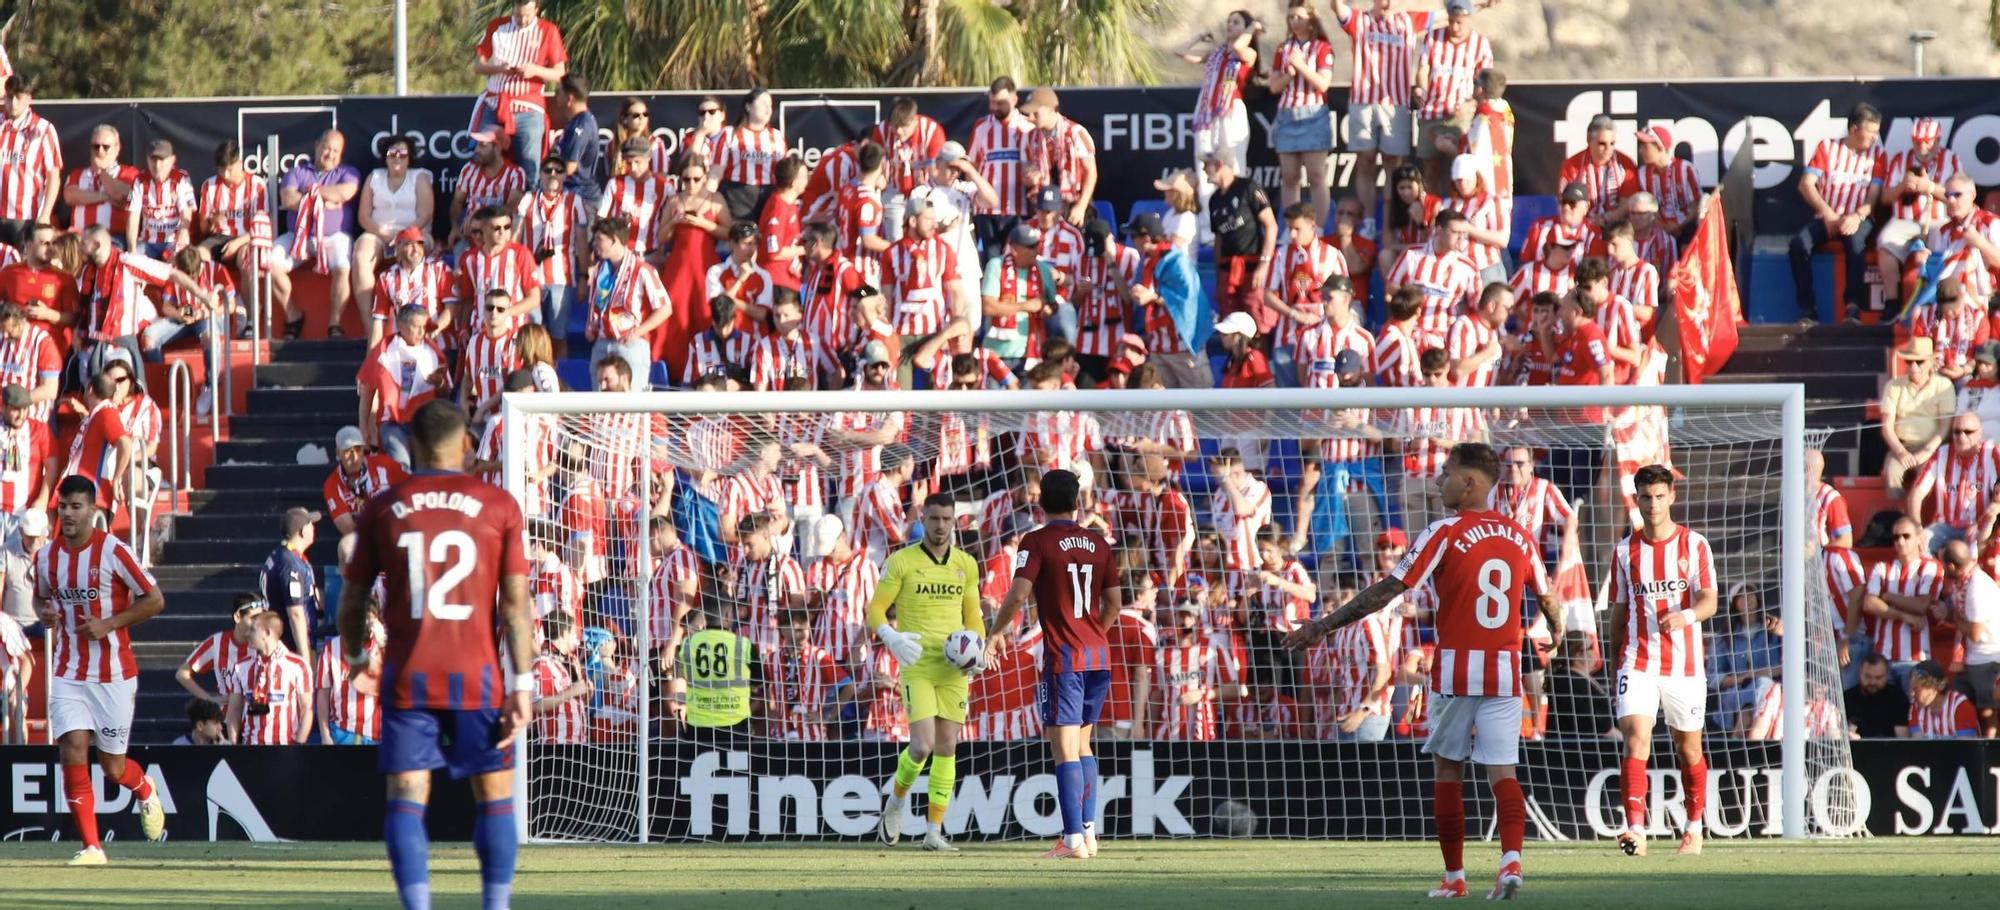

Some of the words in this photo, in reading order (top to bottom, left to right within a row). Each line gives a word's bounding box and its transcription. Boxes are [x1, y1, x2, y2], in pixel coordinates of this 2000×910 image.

[1103, 112, 1196, 150] FIBR
[1059, 536, 1095, 553] ORTUÑO
[397, 529, 477, 620] 12
[915, 583, 963, 595] JALISCO
[1067, 563, 1093, 619] 11
[1634, 580, 1688, 595] JALISCO
[1475, 558, 1512, 629] 8
[696, 642, 728, 678] 68
[1618, 675, 1628, 695] 6
